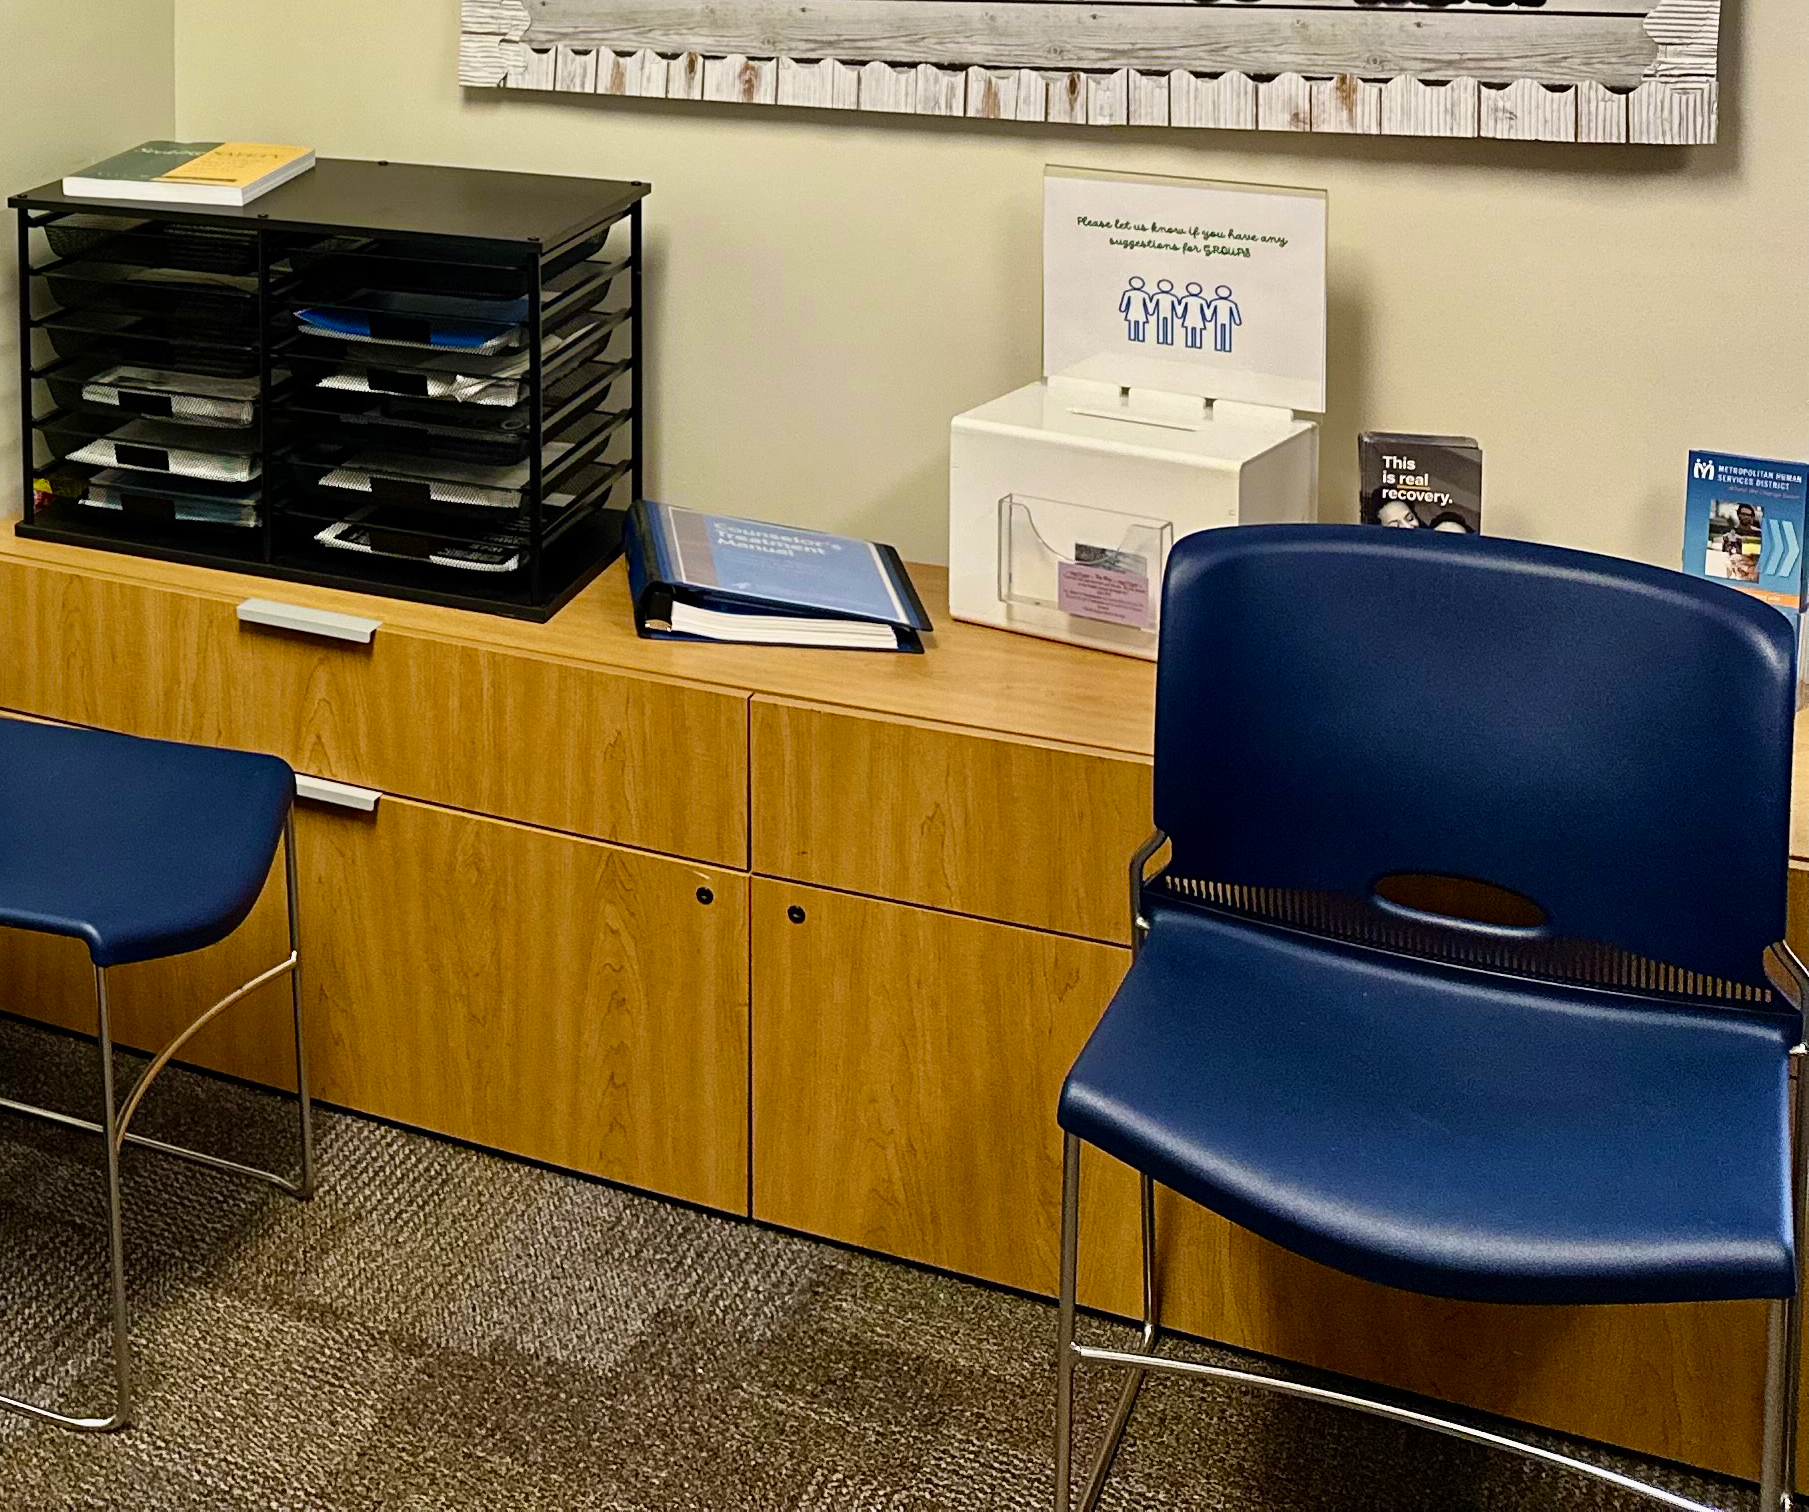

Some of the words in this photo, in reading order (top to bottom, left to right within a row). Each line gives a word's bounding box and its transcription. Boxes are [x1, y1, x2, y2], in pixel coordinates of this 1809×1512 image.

[1077, 216, 1112, 229] Please
[1115, 219, 1131, 231] let
[1134, 223, 1149, 232] us
[1151, 222, 1186, 235] know
[1189, 226, 1200, 238] if
[1202, 229, 1226, 240] you
[1227, 229, 1258, 243] have
[1260, 235, 1288, 248] any
[1109, 238, 1180, 251] suggestions
[1182, 241, 1201, 254] for
[1382, 455, 1416, 470] This
[1382, 470, 1396, 484] is
[1399, 473, 1429, 486] real
[1718, 465, 1774, 479] METROPOLITAN
[1718, 474, 1753, 485] SERVICES
[1756, 479, 1790, 490] DISTRICT
[1382, 488, 1453, 506] recovery.
[713, 522, 842, 551] Counselor's
[717, 531, 825, 555] Treatment
[717, 538, 794, 555] Manual
